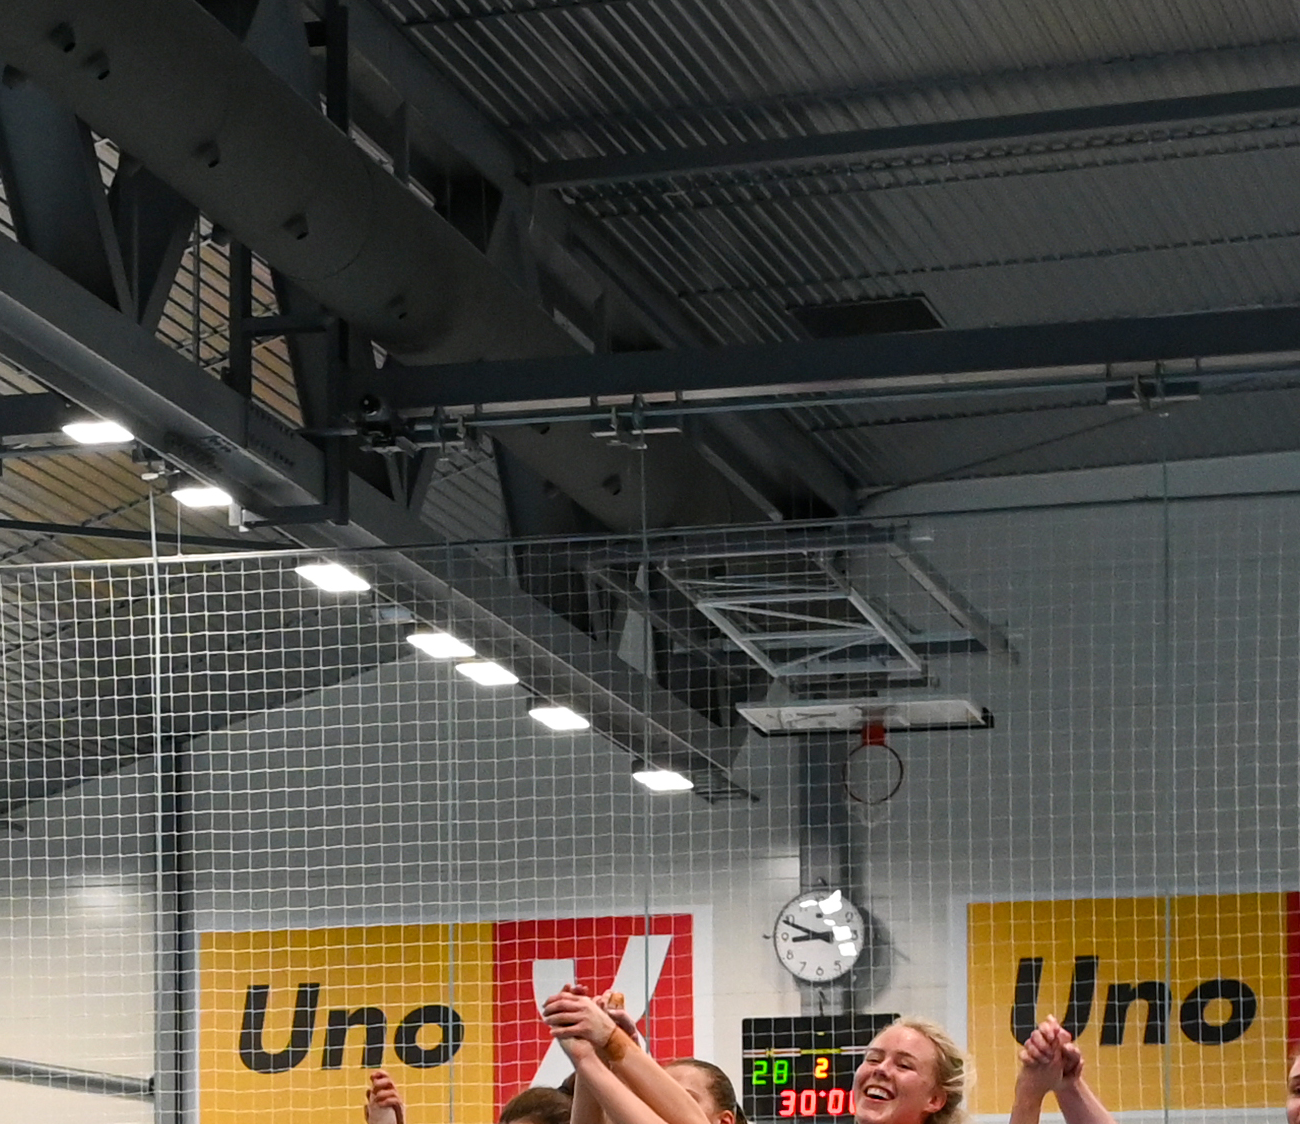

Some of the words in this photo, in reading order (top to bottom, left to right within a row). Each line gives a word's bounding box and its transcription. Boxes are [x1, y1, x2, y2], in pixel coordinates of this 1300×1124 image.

[237, 982, 465, 1074] Uno
[1010, 955, 1257, 1046] Uno
[752, 1060, 789, 1085] 28
[814, 1057, 829, 1078] 2
